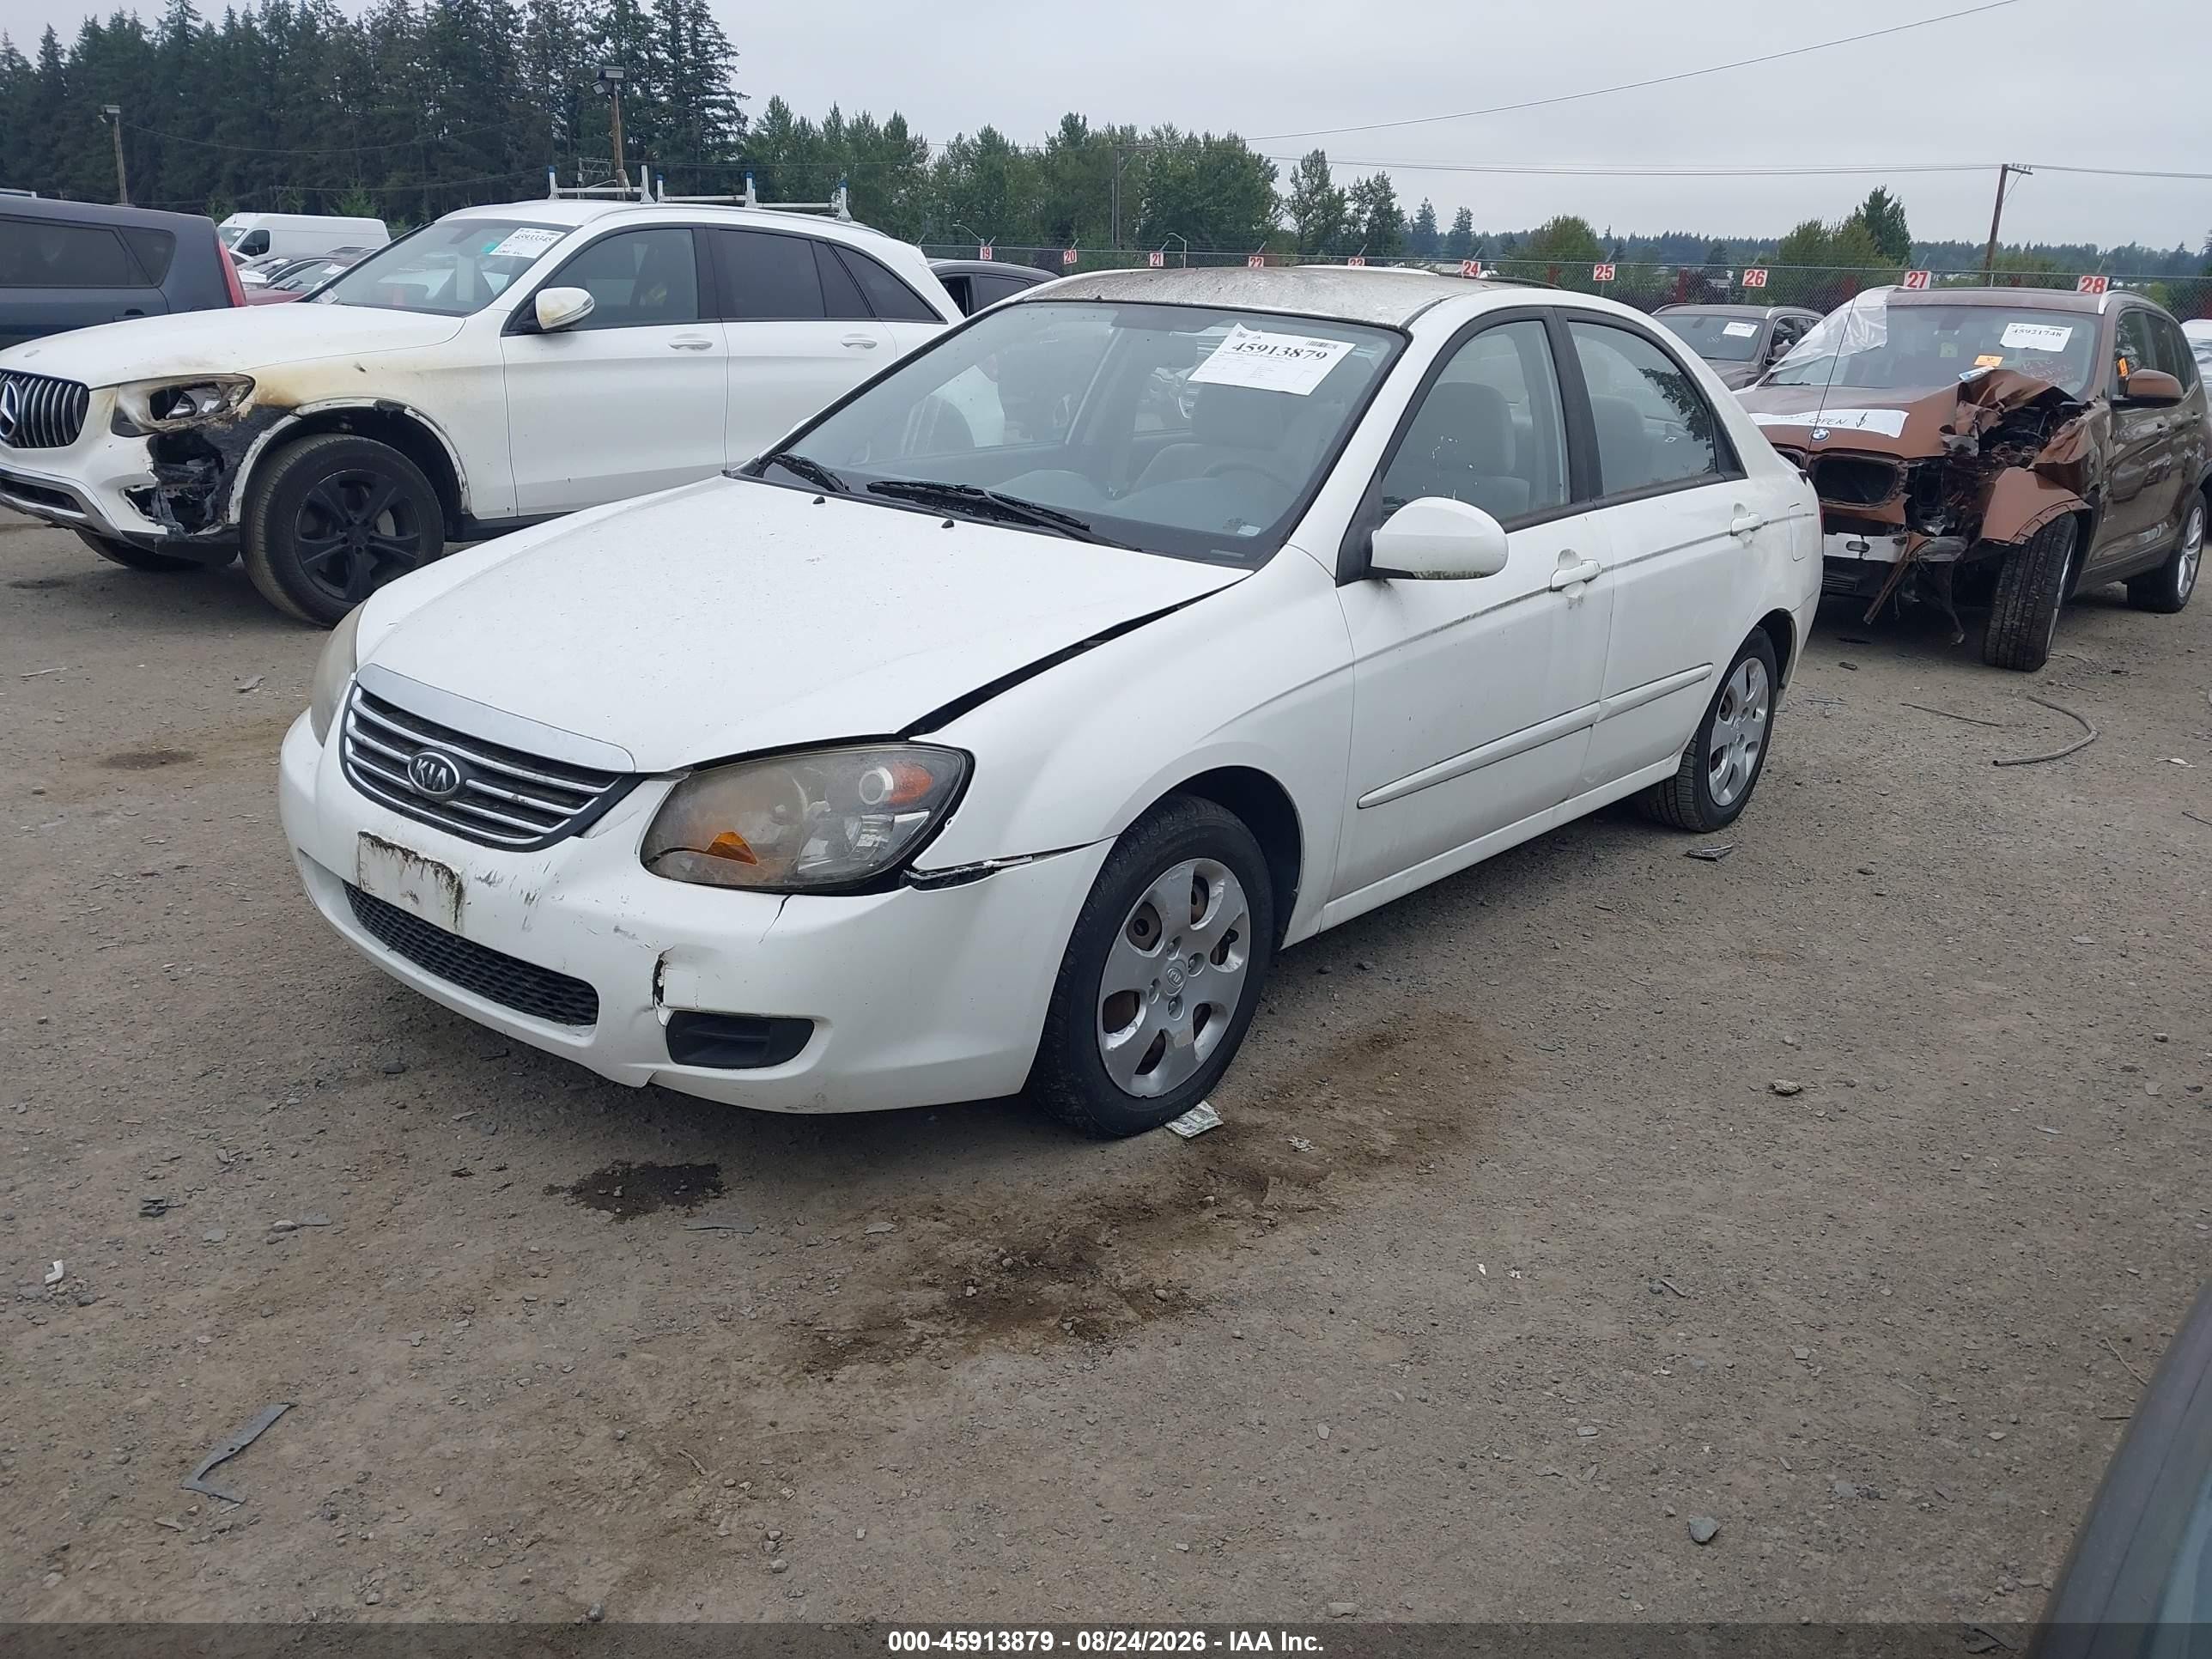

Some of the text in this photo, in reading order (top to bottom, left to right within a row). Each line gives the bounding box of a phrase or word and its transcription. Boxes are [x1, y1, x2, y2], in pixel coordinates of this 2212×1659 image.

[981, 246, 991, 259] 19
[1064, 250, 1077, 264] 20
[1152, 253, 1163, 265] 21
[1464, 262, 1479, 276] 24
[1595, 265, 1613, 280] 25
[1744, 270, 1765, 286] 26
[1906, 271, 1928, 289] 27
[2080, 276, 2106, 294] 28
[1231, 342, 1328, 361] 45913879
[413, 758, 447, 791] KIA
